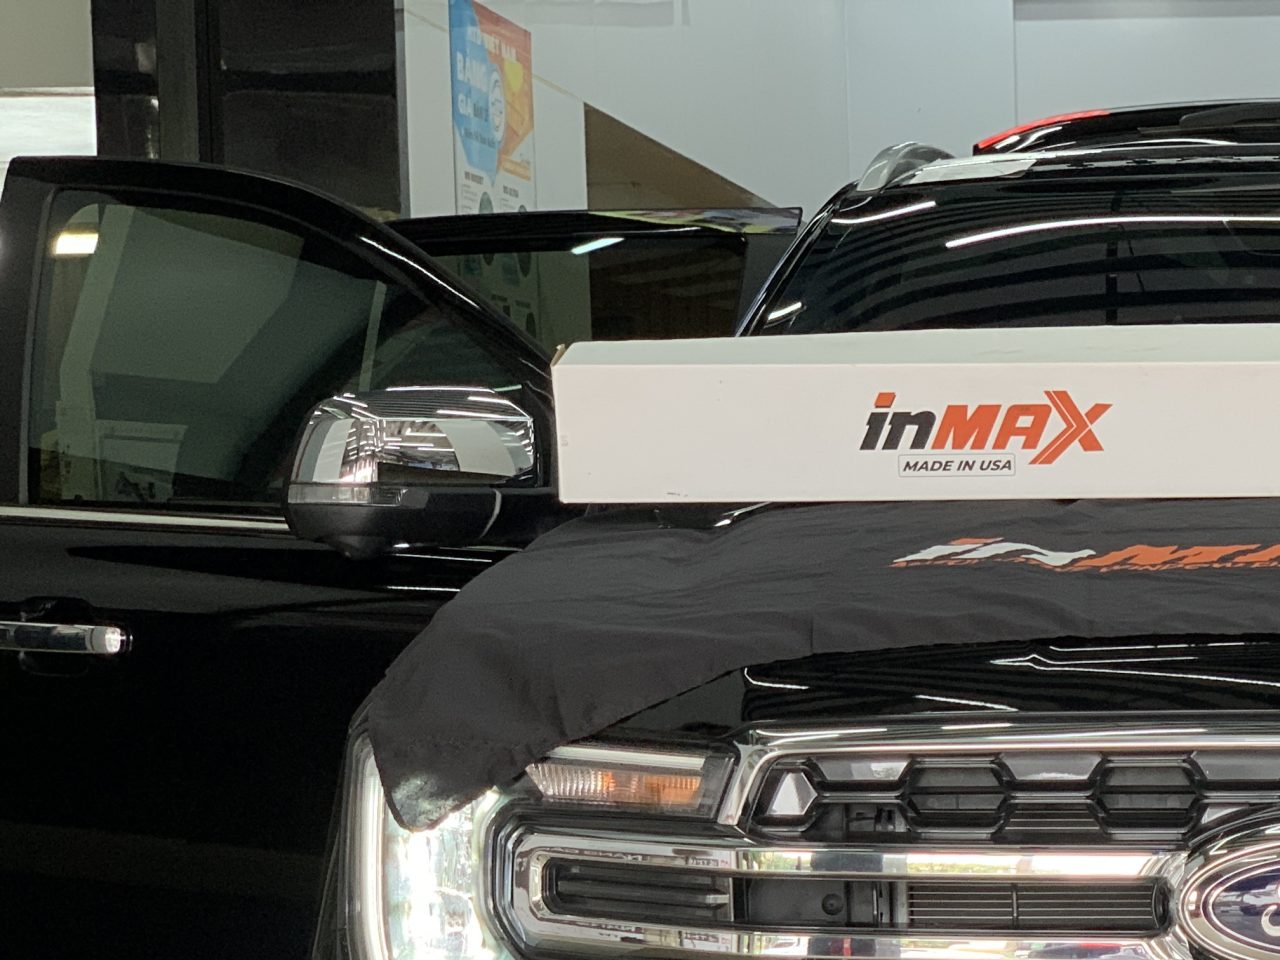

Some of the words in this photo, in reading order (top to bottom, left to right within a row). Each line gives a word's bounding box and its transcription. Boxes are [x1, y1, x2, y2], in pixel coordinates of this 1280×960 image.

[902, 460, 954, 472] MADE
[957, 460, 977, 472] IN
[980, 459, 1013, 472] USA
